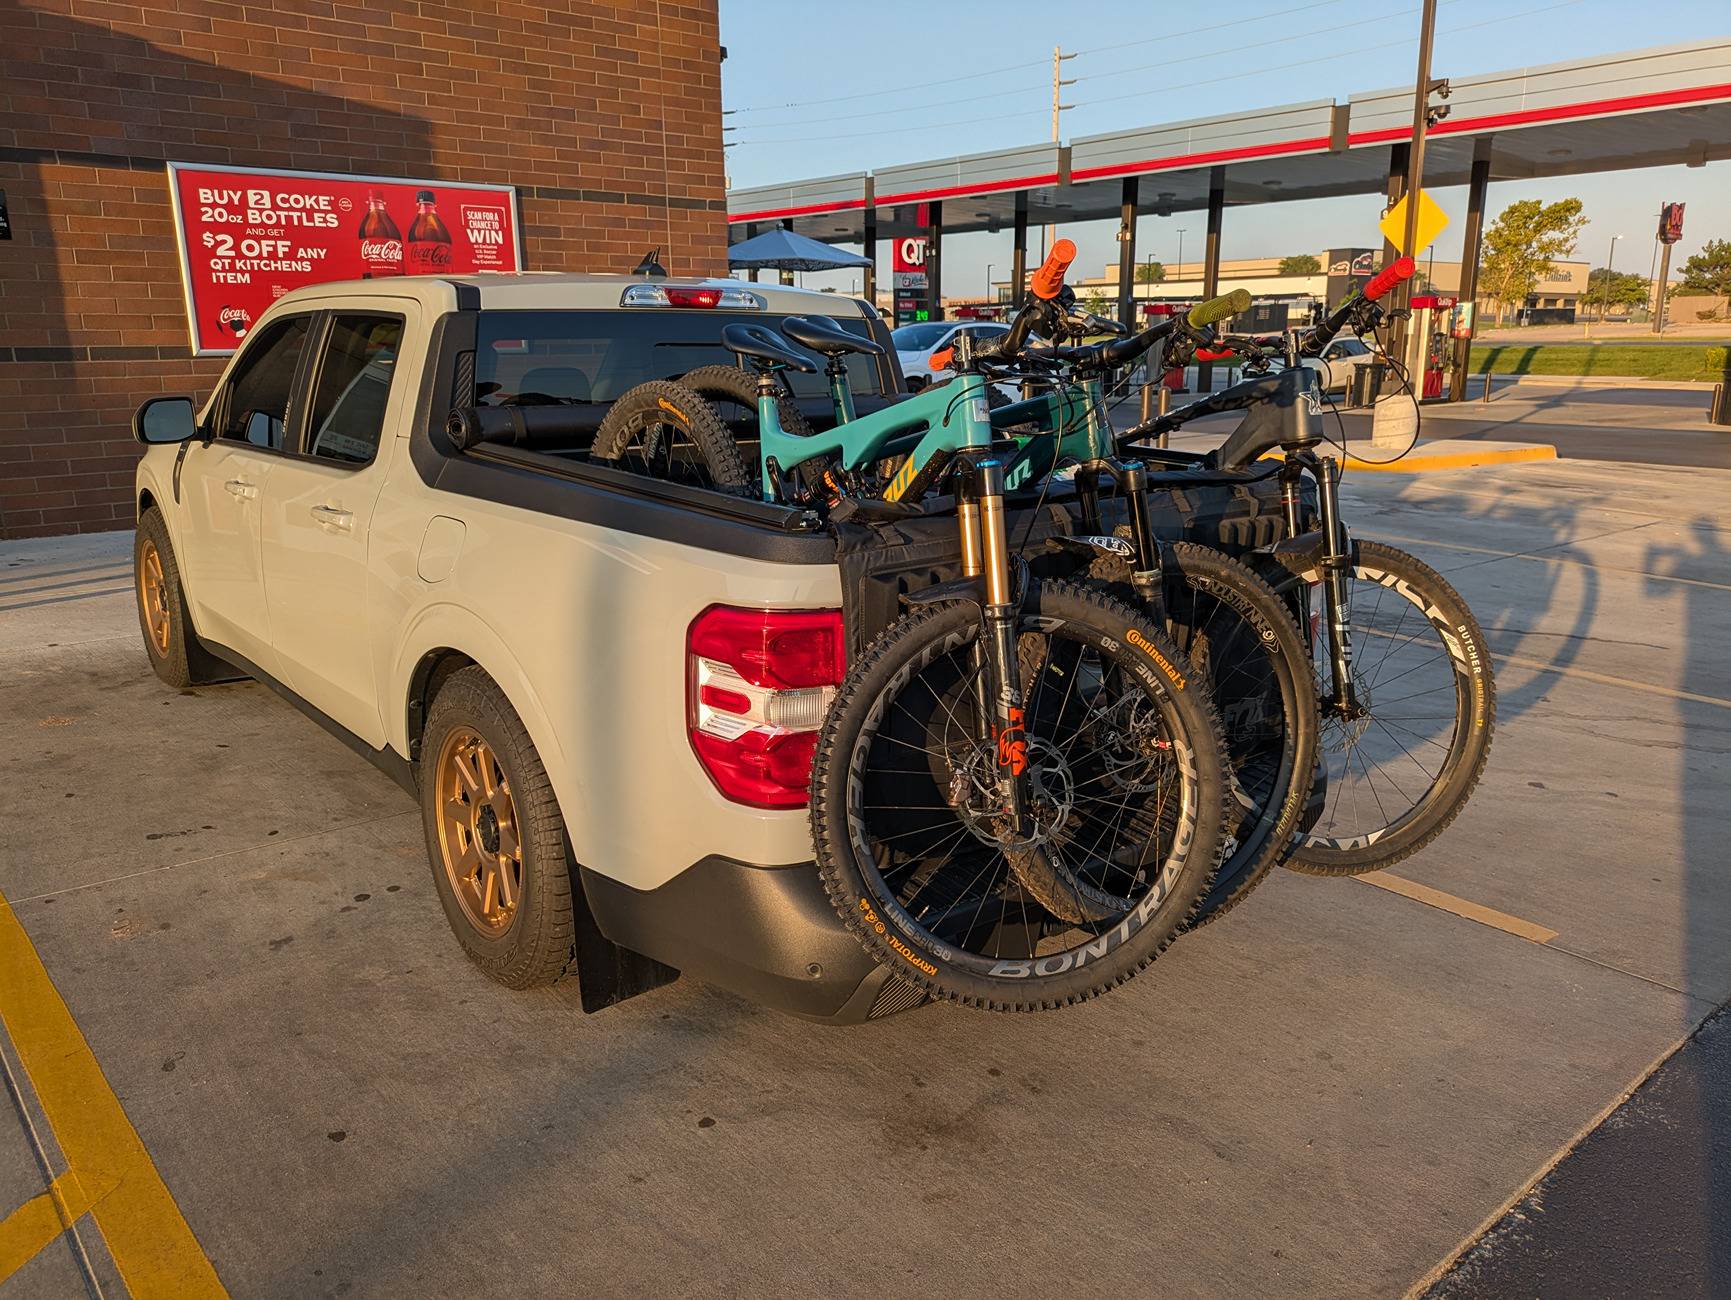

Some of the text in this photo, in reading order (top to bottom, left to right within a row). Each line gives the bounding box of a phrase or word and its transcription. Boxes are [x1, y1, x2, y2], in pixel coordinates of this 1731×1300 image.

[199, 188, 242, 205] BUY
[250, 190, 269, 208] 2
[275, 193, 332, 210] COKE
[247, 209, 339, 228] BOTTLES
[467, 211, 499, 221] SCAN FOR A
[469, 220, 499, 229] CHANCE TO
[202, 231, 327, 260] $2 OFF ANY
[246, 228, 285, 237] AND GET
[466, 228, 504, 244] WIN
[361, 240, 403, 261] Coca-Cola
[901, 238, 926, 266] QT
[210, 258, 312, 272] QT KITCHENS
[212, 272, 251, 284] ITEM
[882, 453, 918, 502] RUZ
[1004, 455, 1033, 491] UZ
[1100, 636, 1119, 652] 30
[1126, 629, 1182, 683] Continental
[1457, 624, 1482, 674] BUTCHER
[1135, 662, 1166, 696] LINE
[848, 616, 1066, 856] BNTRAGER
[1275, 790, 1299, 836] SPECIALIZED
[988, 739, 1199, 978] BONTRAGER
[884, 902, 916, 937] LINE
[933, 945, 952, 961] 30
[889, 935, 938, 977] KRYPTOTAL
